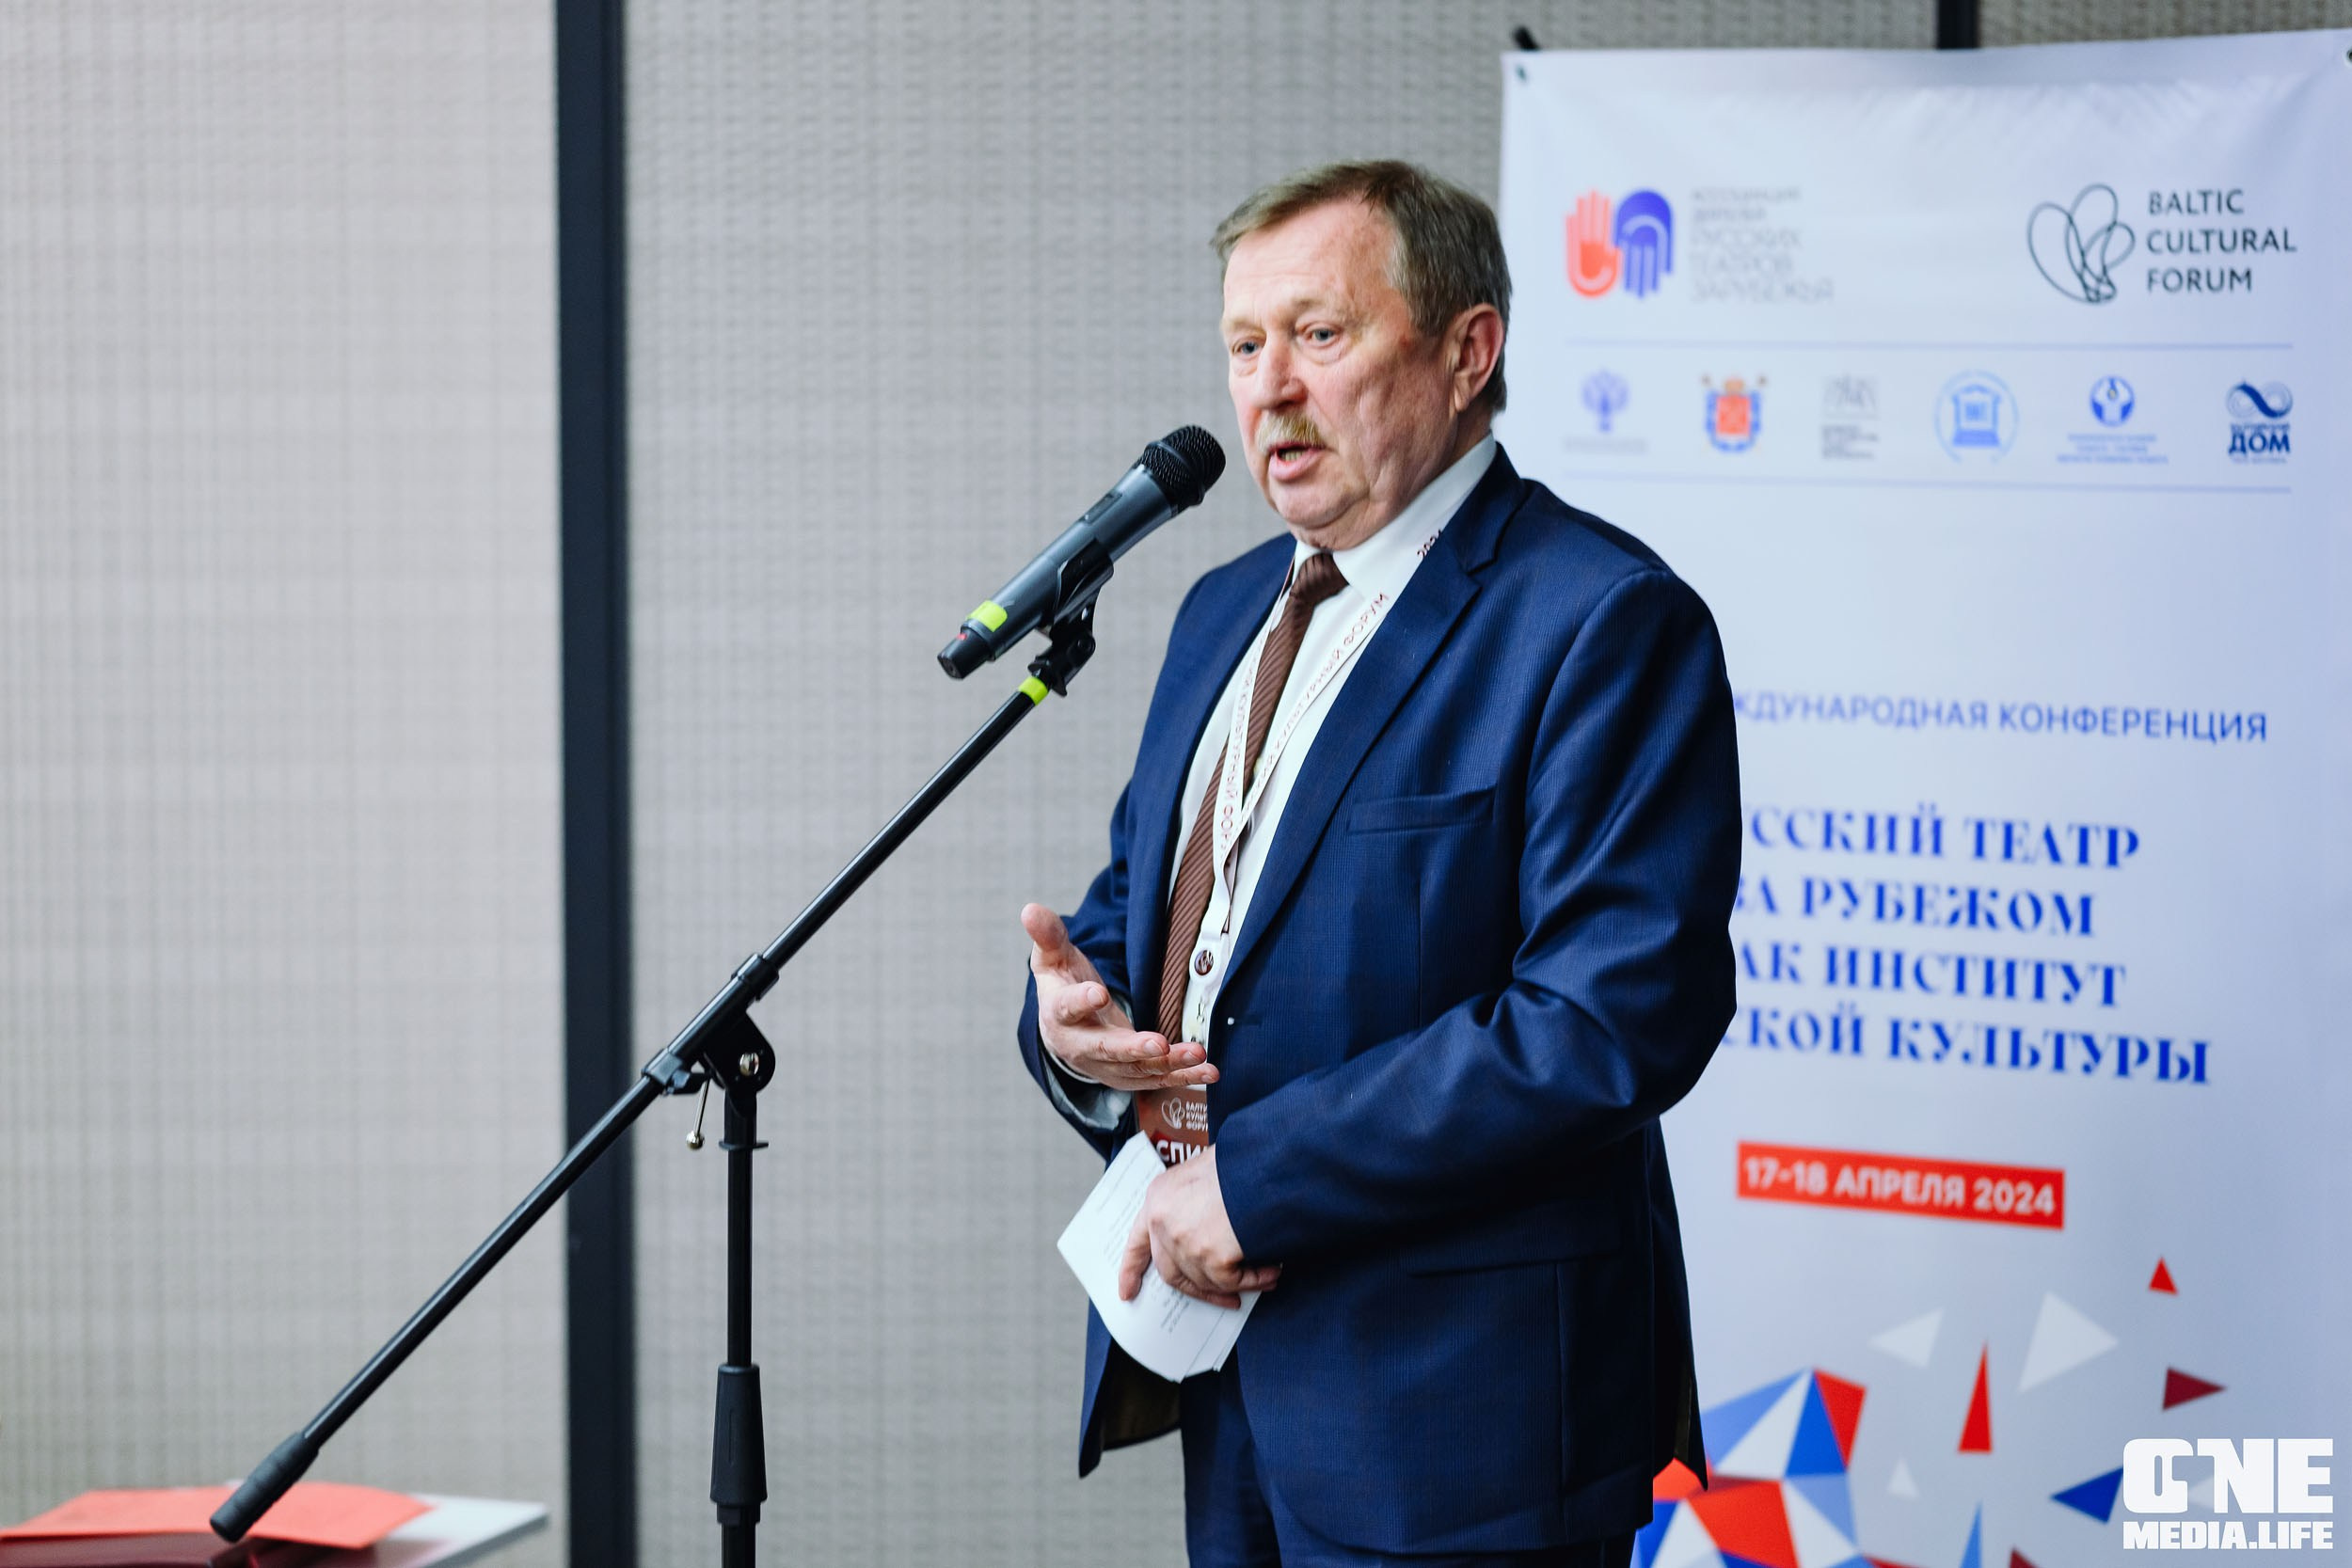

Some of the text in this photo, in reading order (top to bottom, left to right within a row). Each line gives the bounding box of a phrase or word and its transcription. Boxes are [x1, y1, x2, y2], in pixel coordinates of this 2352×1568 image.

[2149, 188, 2244, 215] BALTIC
[2146, 228, 2297, 254] CULTURAL
[2146, 268, 2252, 293] FORUM
[2228, 433, 2291, 455] ДОМ
[1999, 702, 2268, 744] КОНФЕРЕНЦИЯ
[1965, 816, 2140, 868] ТЕАТР
[1801, 876, 2094, 936] РУБЕЖОМ
[1824, 945, 2126, 1007] ИНСТИТУТ
[1887, 1017, 2212, 1085] КУЛЬТУРЫ
[1156, 1139, 1208, 1165] СПИ
[1742, 1156, 2056, 1216] 17-18 АПРЕЛЯ 2024
